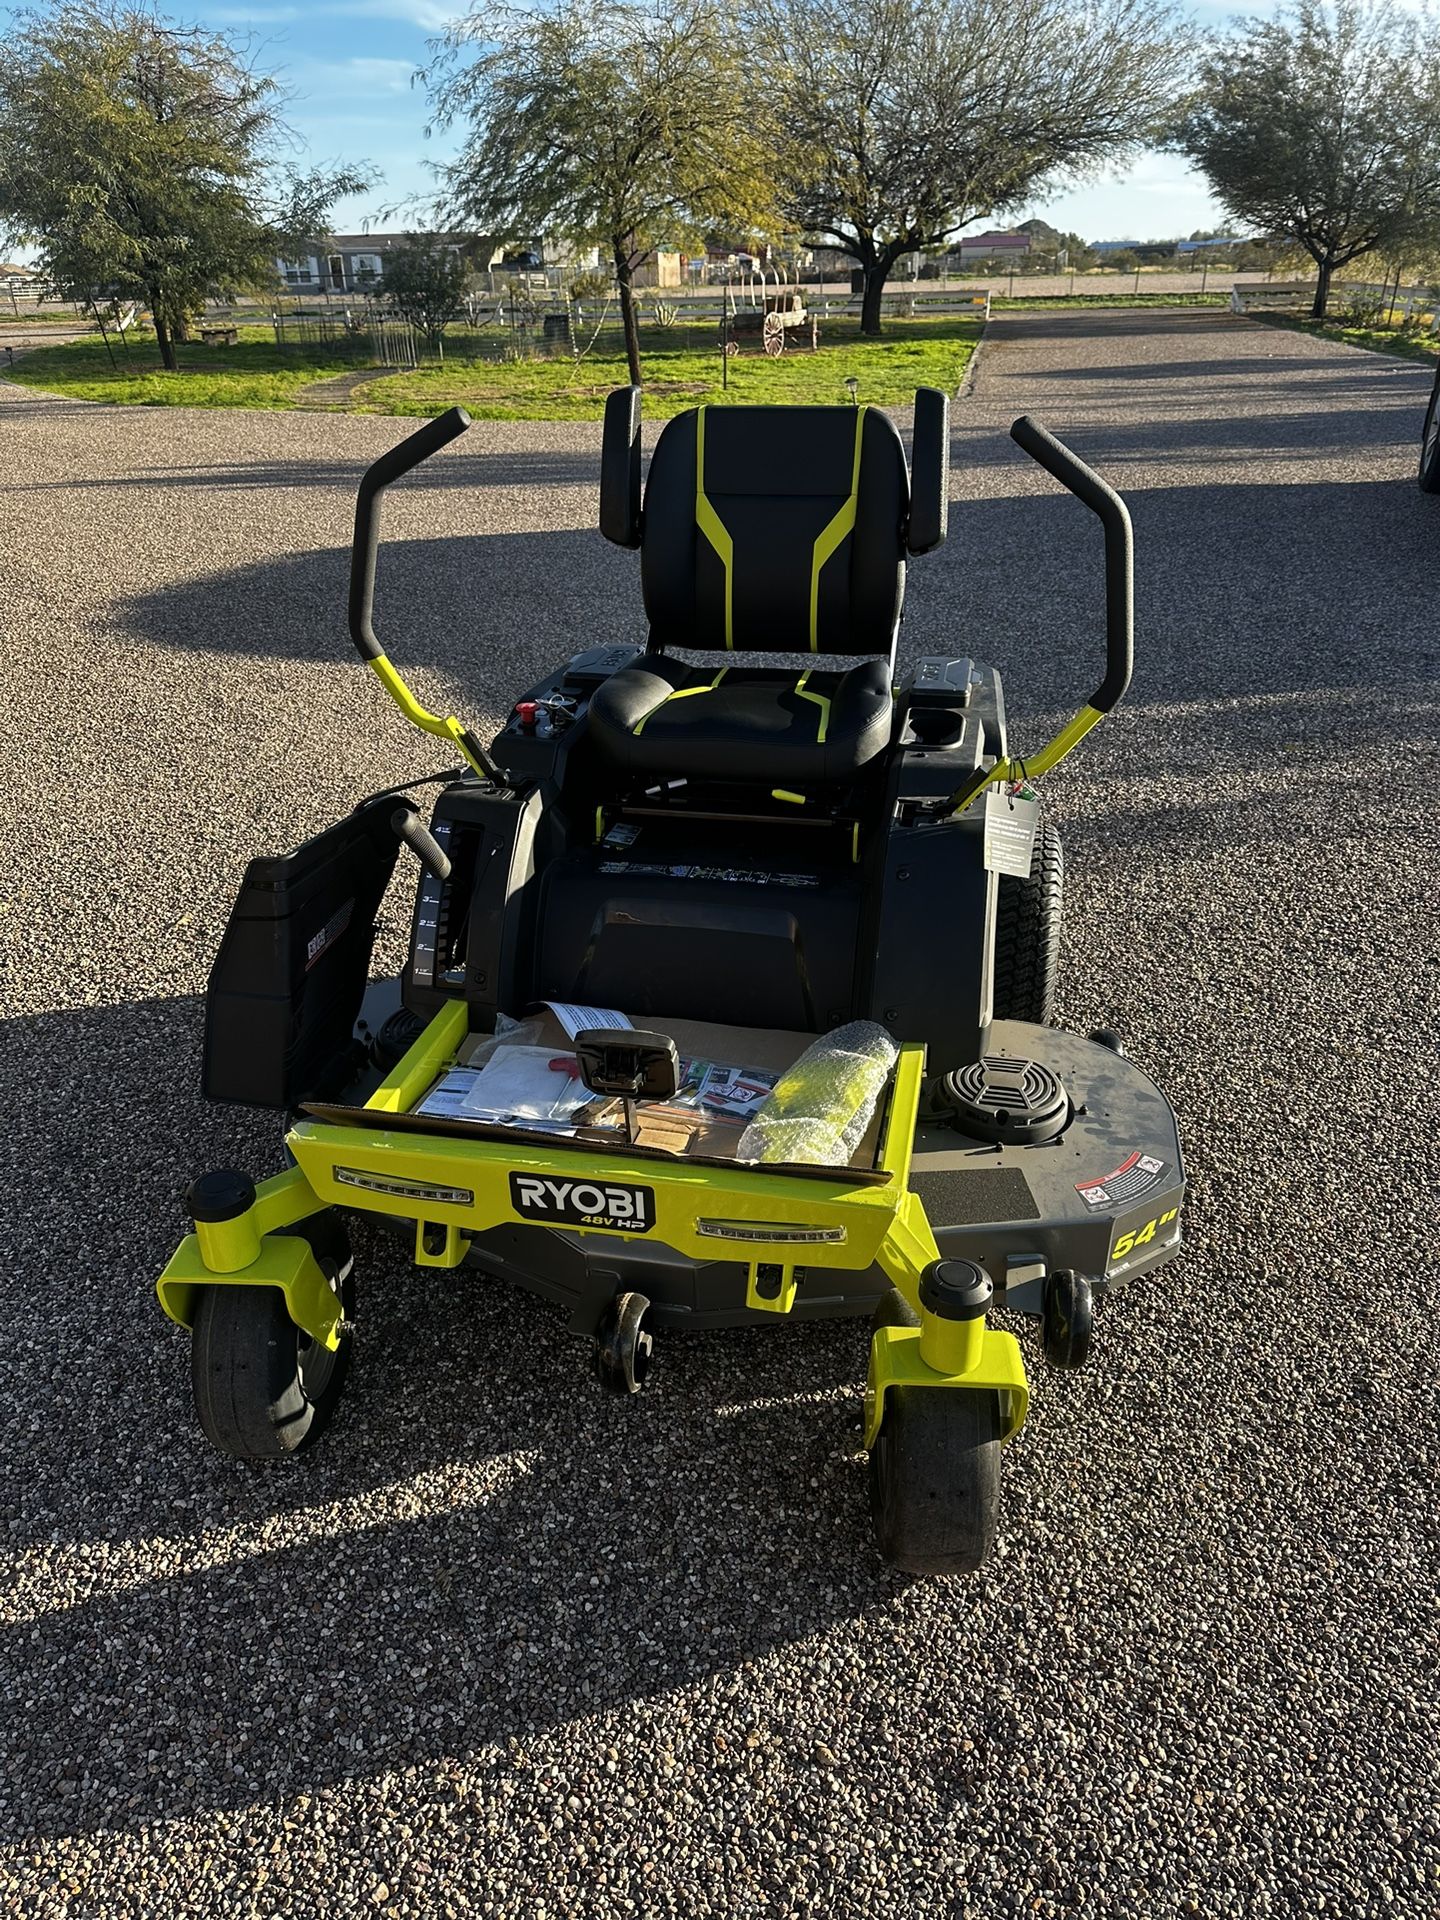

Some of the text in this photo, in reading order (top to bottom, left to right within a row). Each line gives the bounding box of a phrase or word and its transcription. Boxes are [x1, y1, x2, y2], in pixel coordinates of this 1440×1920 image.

[516, 1177, 646, 1220] RYOBI
[580, 1215, 646, 1229] 48V HP
[1111, 1207, 1178, 1260] 54"
